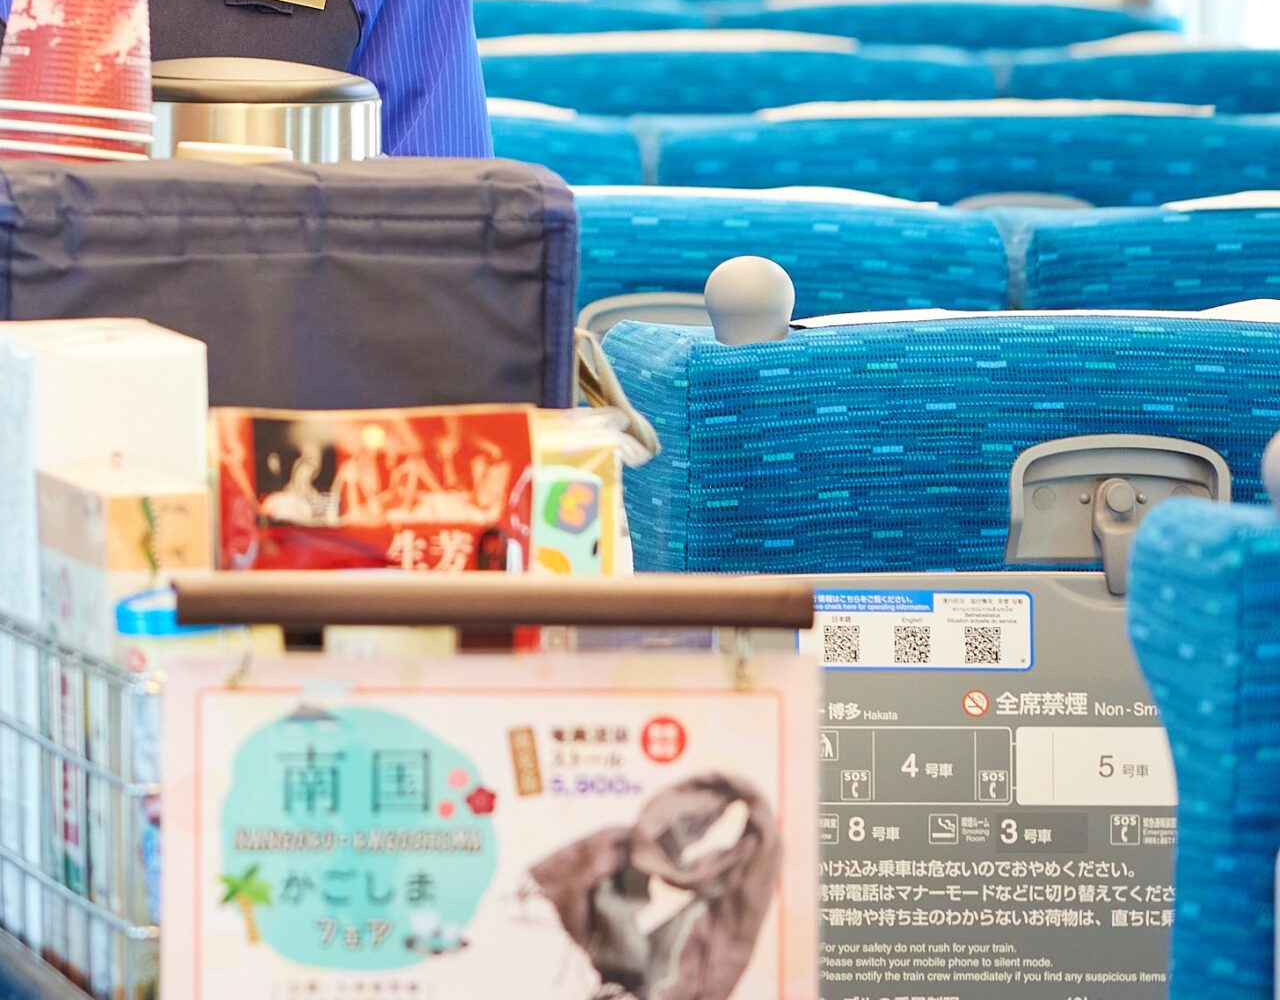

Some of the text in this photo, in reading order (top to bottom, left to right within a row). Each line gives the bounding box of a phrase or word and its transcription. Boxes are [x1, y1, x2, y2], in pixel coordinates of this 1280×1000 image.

[996, 691, 1088, 716] 全席禁煙
[828, 702, 861, 720] 博多
[863, 710, 898, 721] Hakata
[901, 753, 954, 779] 4 号車
[1098, 754, 1150, 779] 5 号車
[277, 744, 431, 818] 南国
[843, 772, 868, 782] SOS
[981, 772, 1006, 782] SOS
[1113, 816, 1137, 826] SOS
[848, 816, 901, 842] 8 号車
[961, 828, 990, 837] Smoking
[1000, 818, 1052, 844] 3 号車
[966, 835, 986, 843] Room
[279, 868, 438, 904] かごしま
[838, 944, 860, 955] your
[862, 942, 893, 955] safety
[894, 942, 908, 953] do
[910, 943, 926, 953] not
[928, 942, 951, 953] rush
[952, 942, 966, 953] for
[968, 944, 990, 955] your
[992, 942, 1017, 953] train.
[855, 957, 886, 967] switch
[889, 959, 910, 969] your
[913, 957, 946, 967] mobile
[948, 957, 979, 969] phone
[982, 958, 992, 967] to
[994, 957, 1021, 967] silent
[1023, 957, 1054, 967] mode.
[855, 971, 883, 983] notify
[885, 971, 901, 981] the
[903, 971, 925, 981] train
[927, 973, 951, 981] crew
[953, 971, 1013, 983] immediately
[1015, 971, 1022, 981] if
[1024, 973, 1042, 984] you
[1044, 971, 1063, 981] find
[1065, 973, 1083, 984] any
[1085, 971, 1138, 984] suspicious
[1140, 972, 1167, 982] items
